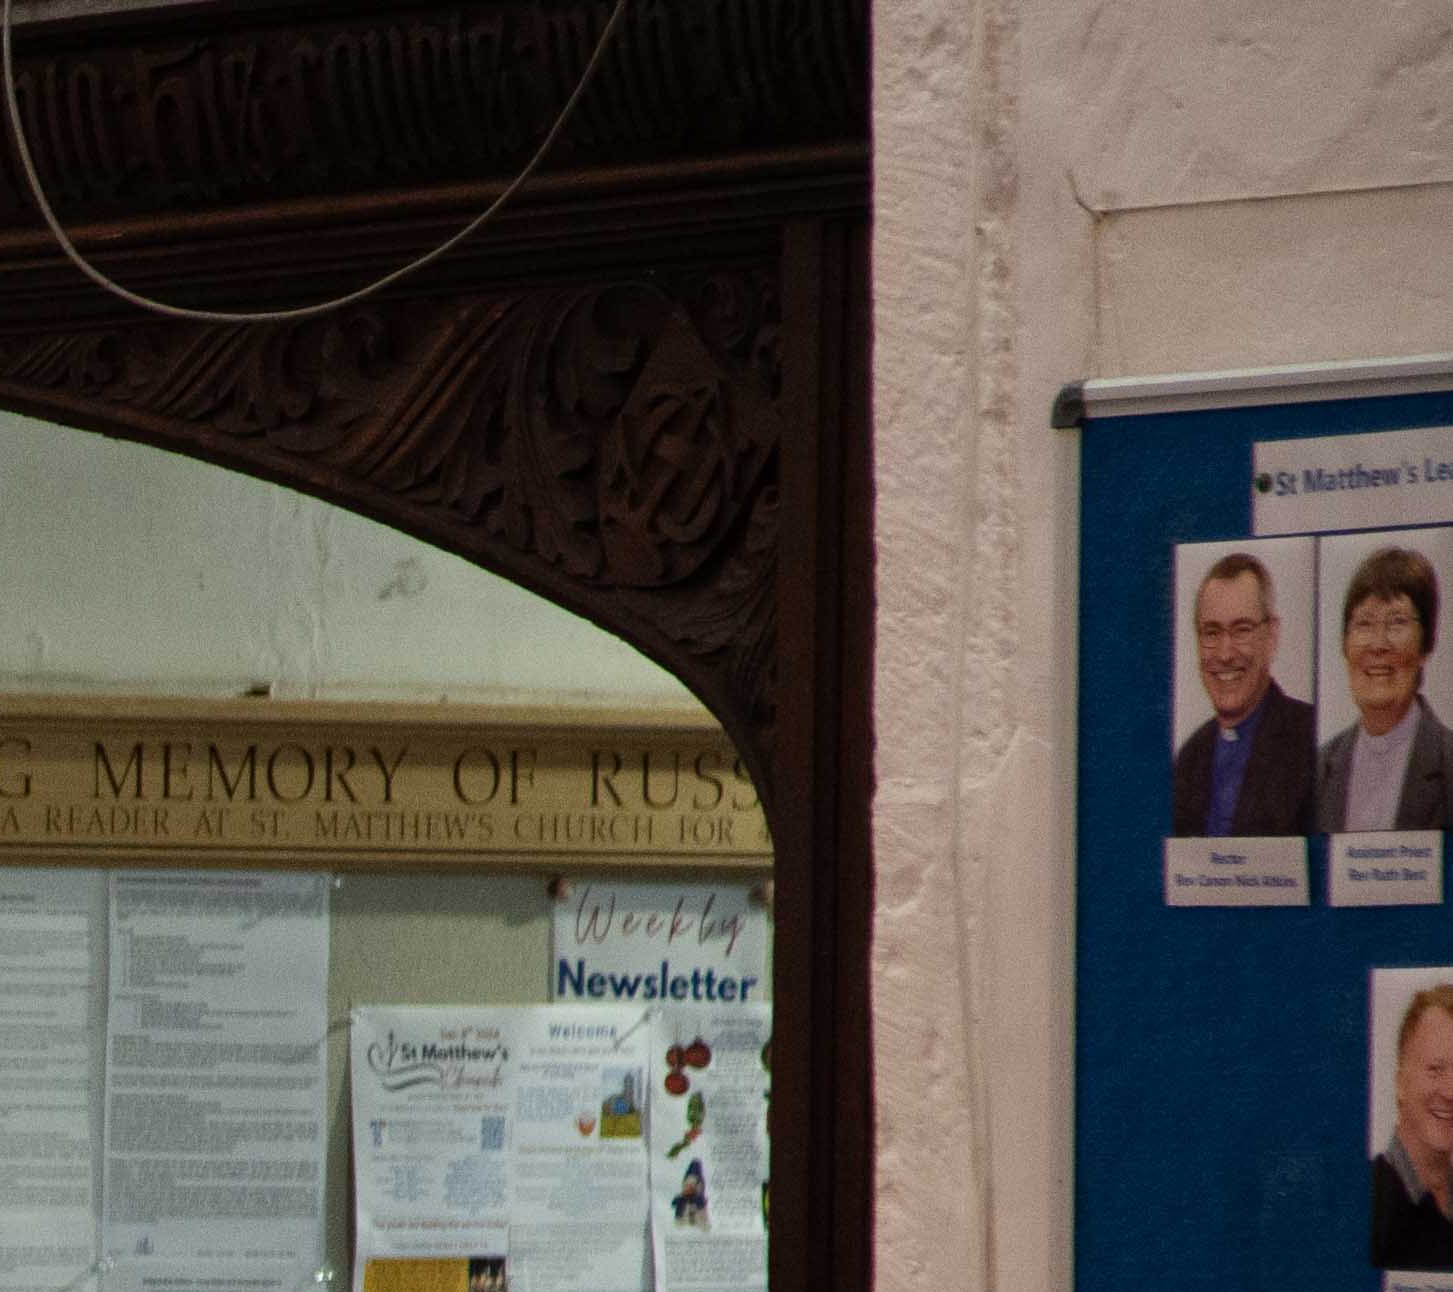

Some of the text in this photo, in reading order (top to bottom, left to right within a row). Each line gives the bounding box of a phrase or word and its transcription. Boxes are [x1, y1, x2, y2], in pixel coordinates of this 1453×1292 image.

[1275, 471, 1297, 496] St
[1302, 460, 1419, 492] Matthew's
[92, 741, 409, 803] MEMORY
[451, 746, 538, 806] OF
[1, 804, 21, 834] A
[44, 806, 170, 836] READER
[193, 807, 230, 837] AT
[314, 810, 493, 842] MATTHEW'S
[513, 813, 653, 843] CHURCH
[679, 815, 735, 845] FOR
[575, 887, 746, 957] Weekly
[557, 958, 758, 1001] Newsletter
